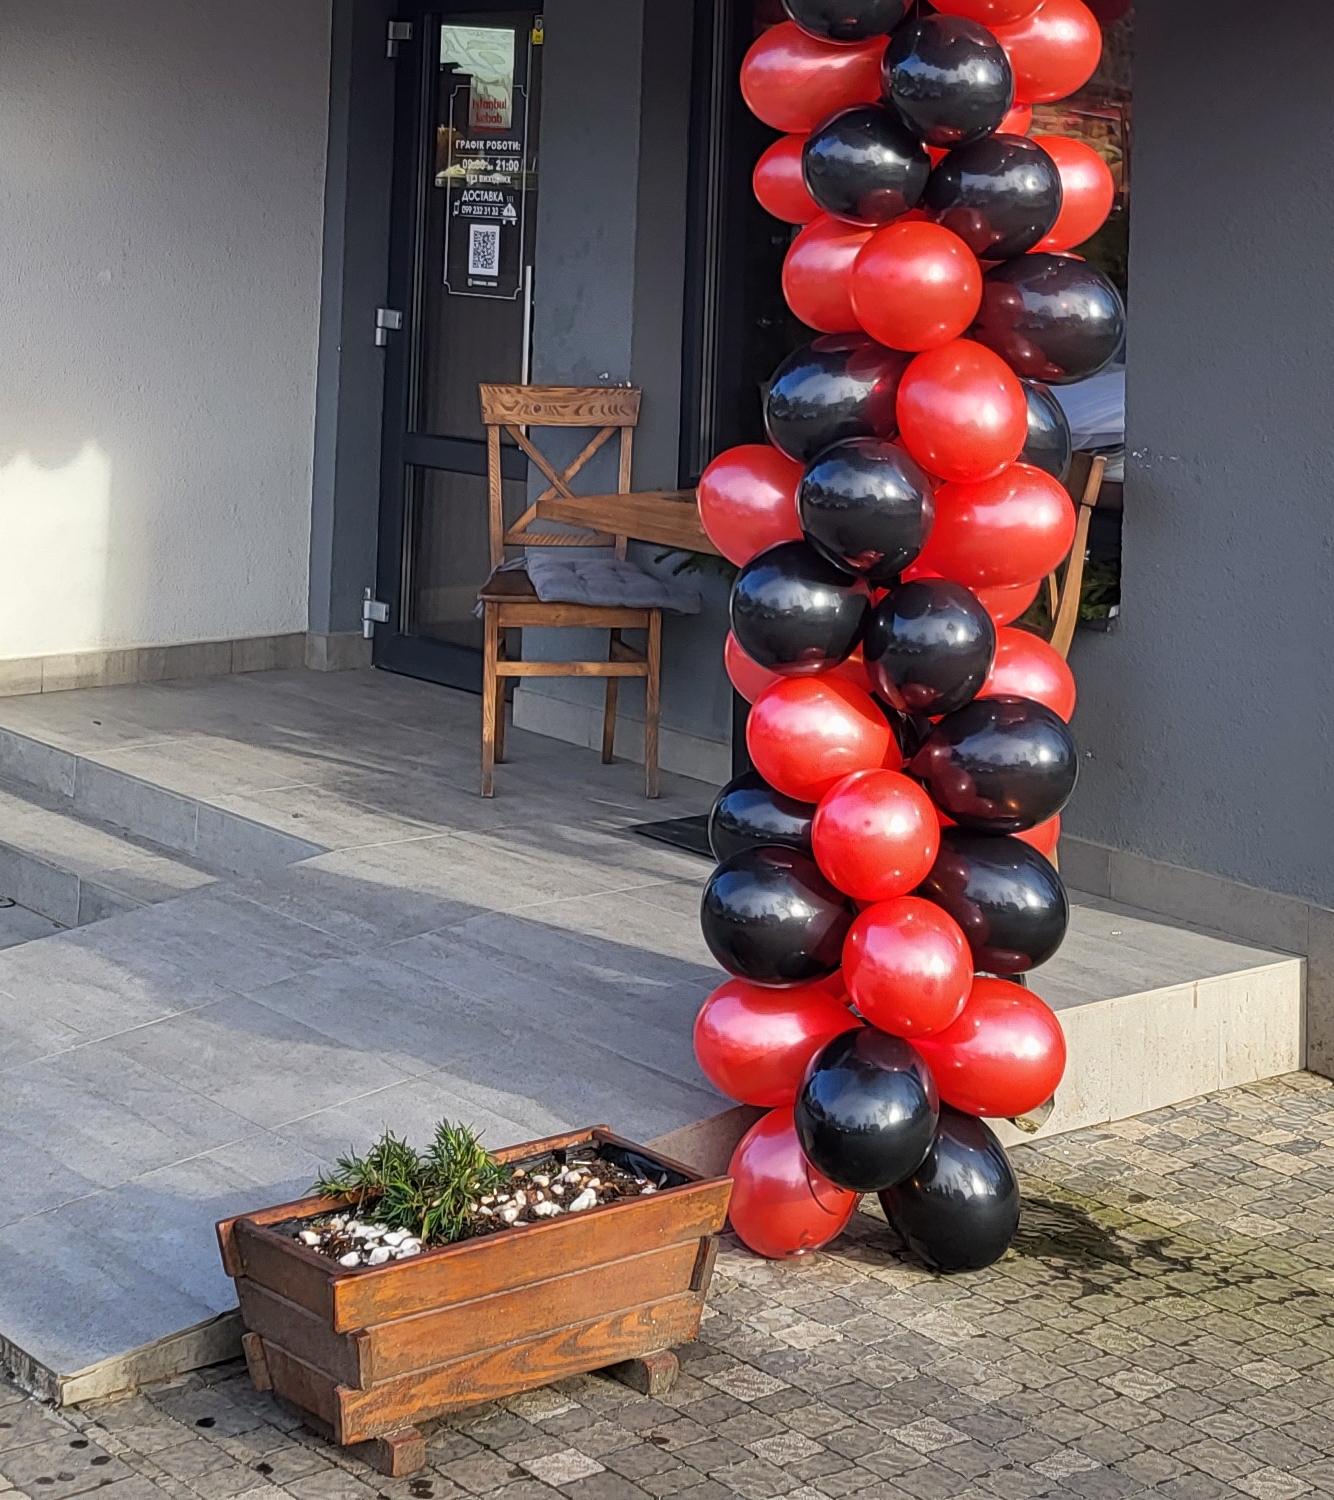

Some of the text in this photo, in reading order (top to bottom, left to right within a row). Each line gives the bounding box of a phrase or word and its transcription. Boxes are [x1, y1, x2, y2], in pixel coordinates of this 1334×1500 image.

[455, 139, 522, 152] ГРАФІК РОБОТИ:
[495, 159, 520, 172] 21:00
[461, 190, 504, 202] ДОСТАВКА
